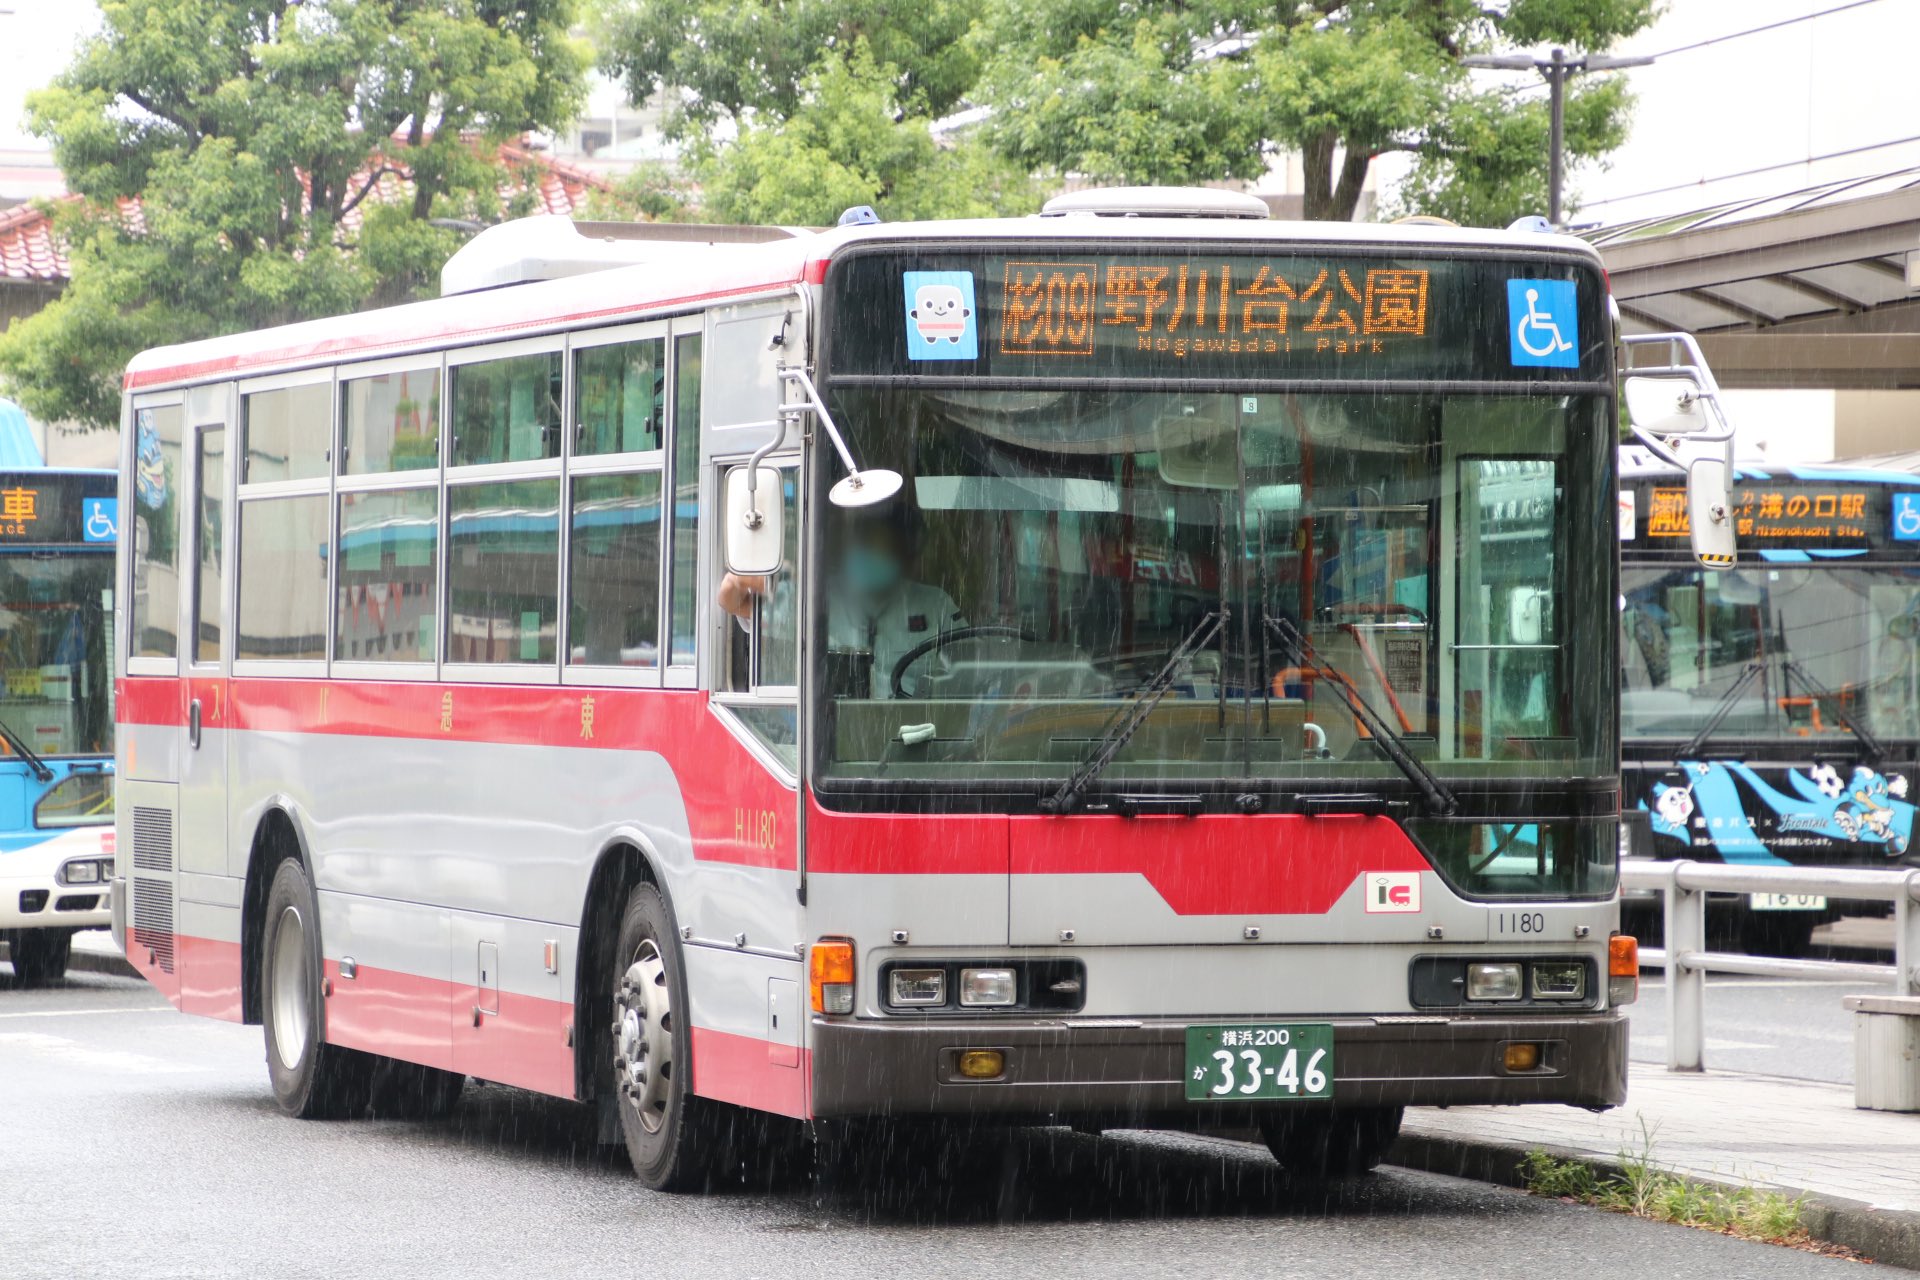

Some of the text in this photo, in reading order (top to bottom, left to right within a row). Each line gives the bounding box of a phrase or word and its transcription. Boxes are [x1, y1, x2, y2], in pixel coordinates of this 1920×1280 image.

[1006, 265, 1430, 346] 杉09 野川台公園
[1136, 335, 1385, 357] Nogawadai Park
[0, 486, 38, 524] 車
[1758, 491, 1866, 519] 溝の口駅
[735, 807, 777, 850] H1180
[1499, 913, 1544, 933] 1180
[1193, 1048, 1327, 1095] か 33-46
